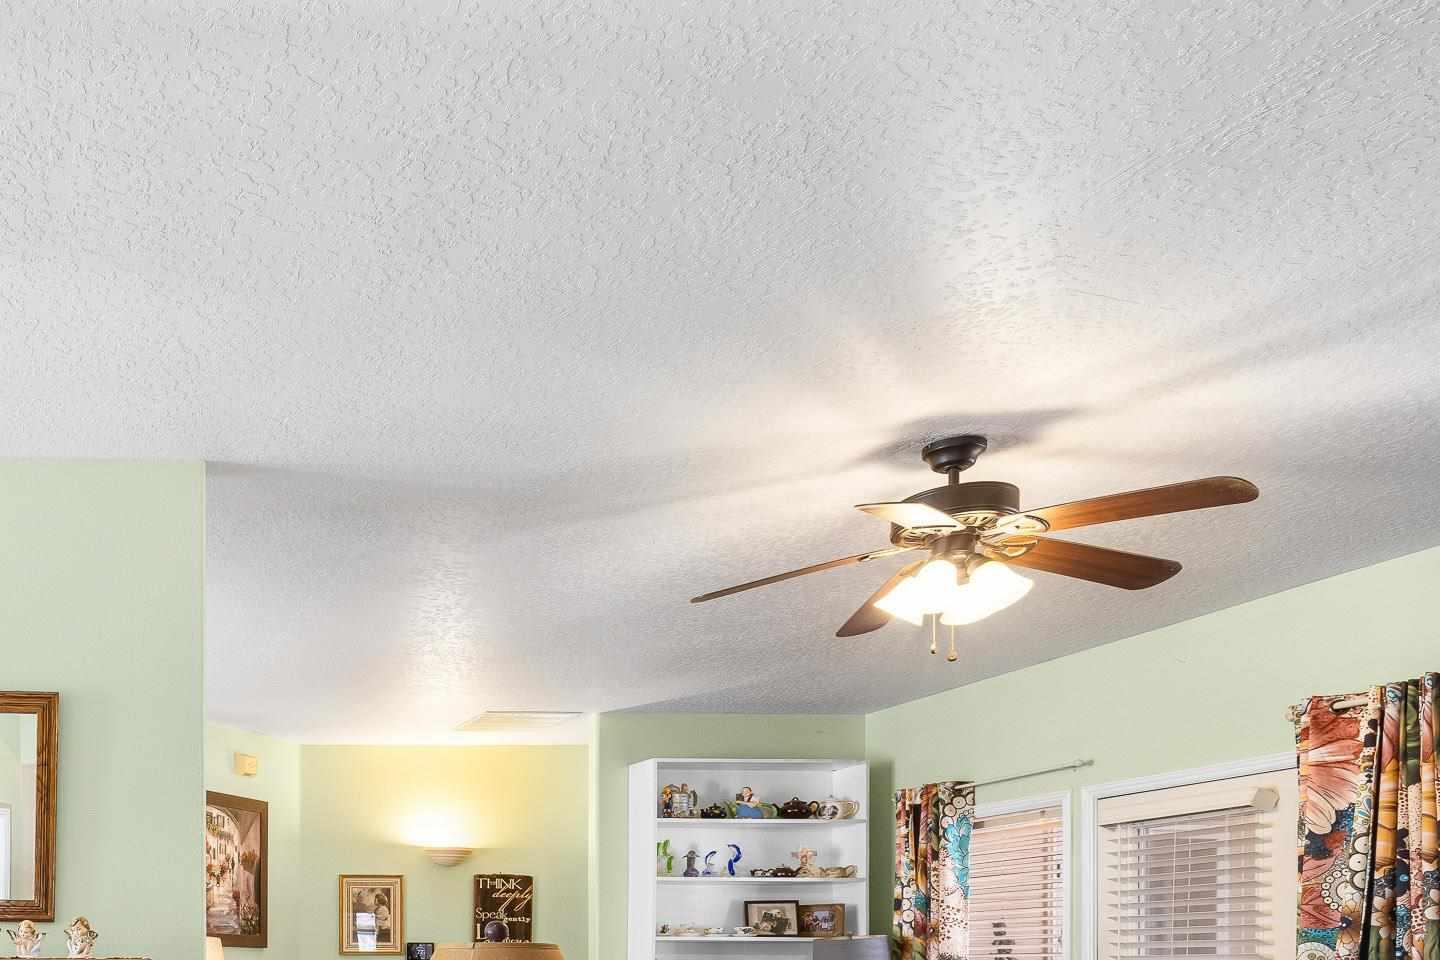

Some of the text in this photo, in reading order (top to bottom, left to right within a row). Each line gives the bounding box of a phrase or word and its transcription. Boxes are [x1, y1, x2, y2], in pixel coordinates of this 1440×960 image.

[476, 878, 523, 890] THINK
[492, 884, 534, 912] deeply
[475, 907, 508, 921] Speak
